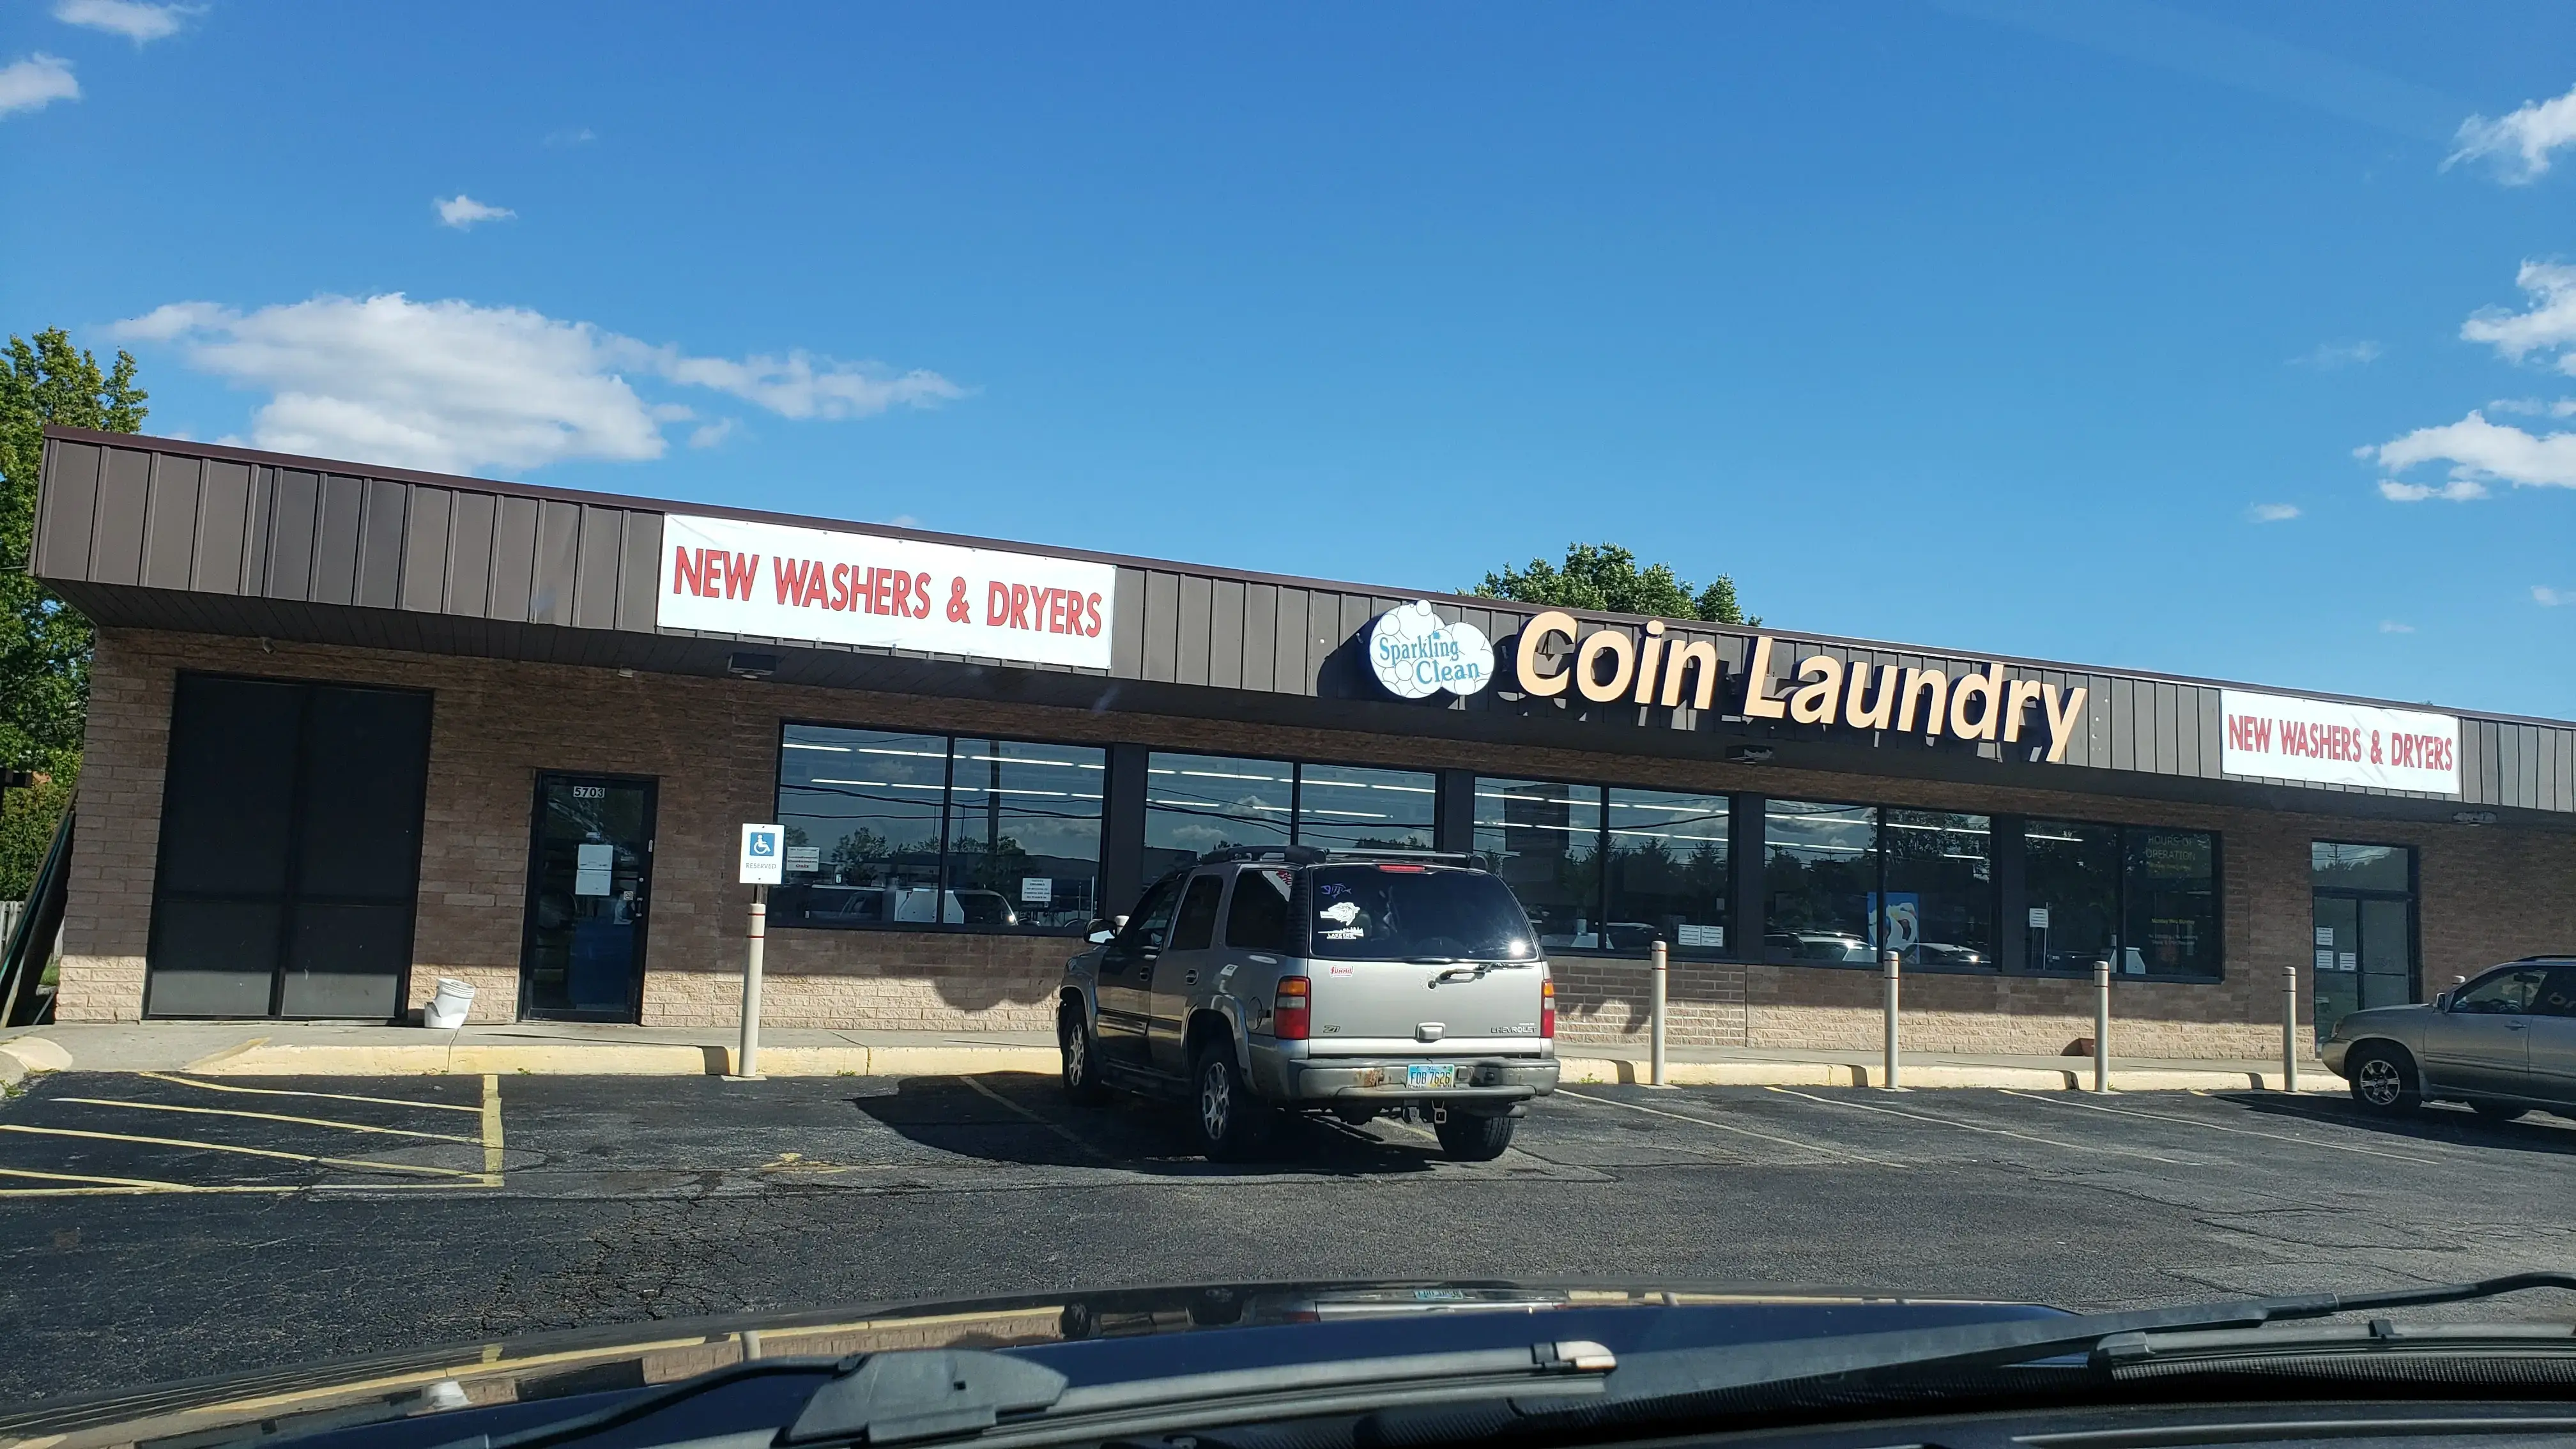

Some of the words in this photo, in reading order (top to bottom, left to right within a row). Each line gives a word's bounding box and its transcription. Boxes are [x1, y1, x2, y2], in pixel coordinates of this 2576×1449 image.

[674, 546, 760, 601] NEW
[773, 556, 931, 619] WASHERS
[946, 576, 970, 624] &
[987, 581, 1102, 638] DRYERS
[1379, 631, 1459, 666] Sparkling
[1416, 659, 1480, 684] Clean
[1516, 611, 1717, 710] Coin
[1744, 636, 2087, 762] Laundry
[2228, 714, 2272, 753] NEW
[2279, 719, 2361, 763] WASHERS
[2370, 730, 2383, 765] &
[2391, 732, 2453, 772] DRYERS
[574, 787, 604, 797] 5703
[2148, 835, 2179, 846] HOURS
[2145, 848, 2196, 861] OPERATION
[1430, 1071, 1451, 1084] 7626
